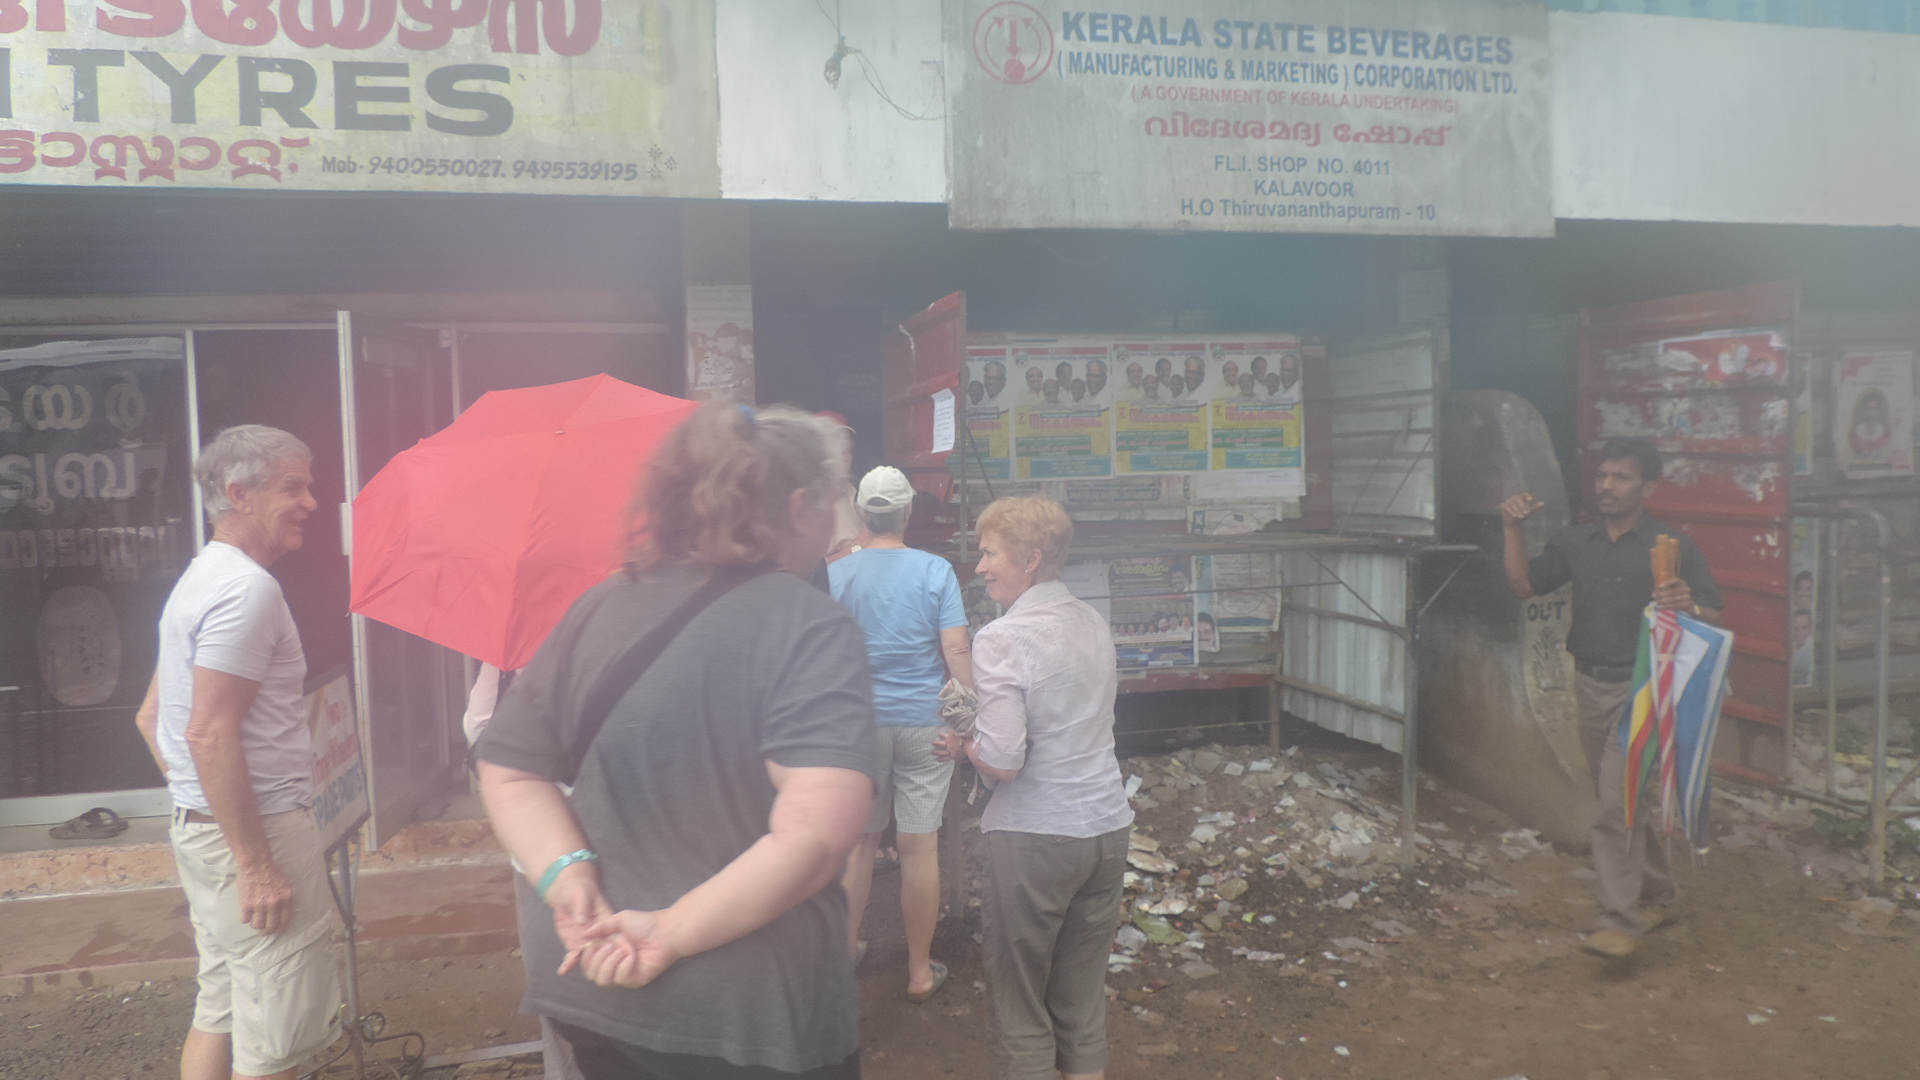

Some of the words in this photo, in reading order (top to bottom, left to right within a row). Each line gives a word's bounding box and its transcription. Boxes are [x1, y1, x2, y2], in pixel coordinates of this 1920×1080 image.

[1062, 11, 1202, 47] KERALA
[1213, 19, 1316, 53] STATE
[1327, 26, 1513, 64] BEVERAGES
[1223, 62, 1236, 80] &
[1354, 68, 1477, 92] CORPORATION
[1481, 71, 1517, 94] LTD.
[47, 48, 514, 136] TYRES
[1155, 86, 1261, 104] GOVERNMENT
[1267, 90, 1286, 104] OF
[1291, 91, 1349, 107] KERALA
[512, 160, 638, 181] 9495539195
[1257, 156, 1307, 173] SHOP
[1318, 158, 1348, 174] NO.
[1353, 159, 1390, 175] 4011
[1254, 180, 1355, 197] KALAVOOR
[1181, 198, 1214, 217] H.O
[1220, 199, 1400, 221] Thiruvananthapuram
[1417, 205, 1436, 220] 10
[1526, 601, 1567, 622] OUT
